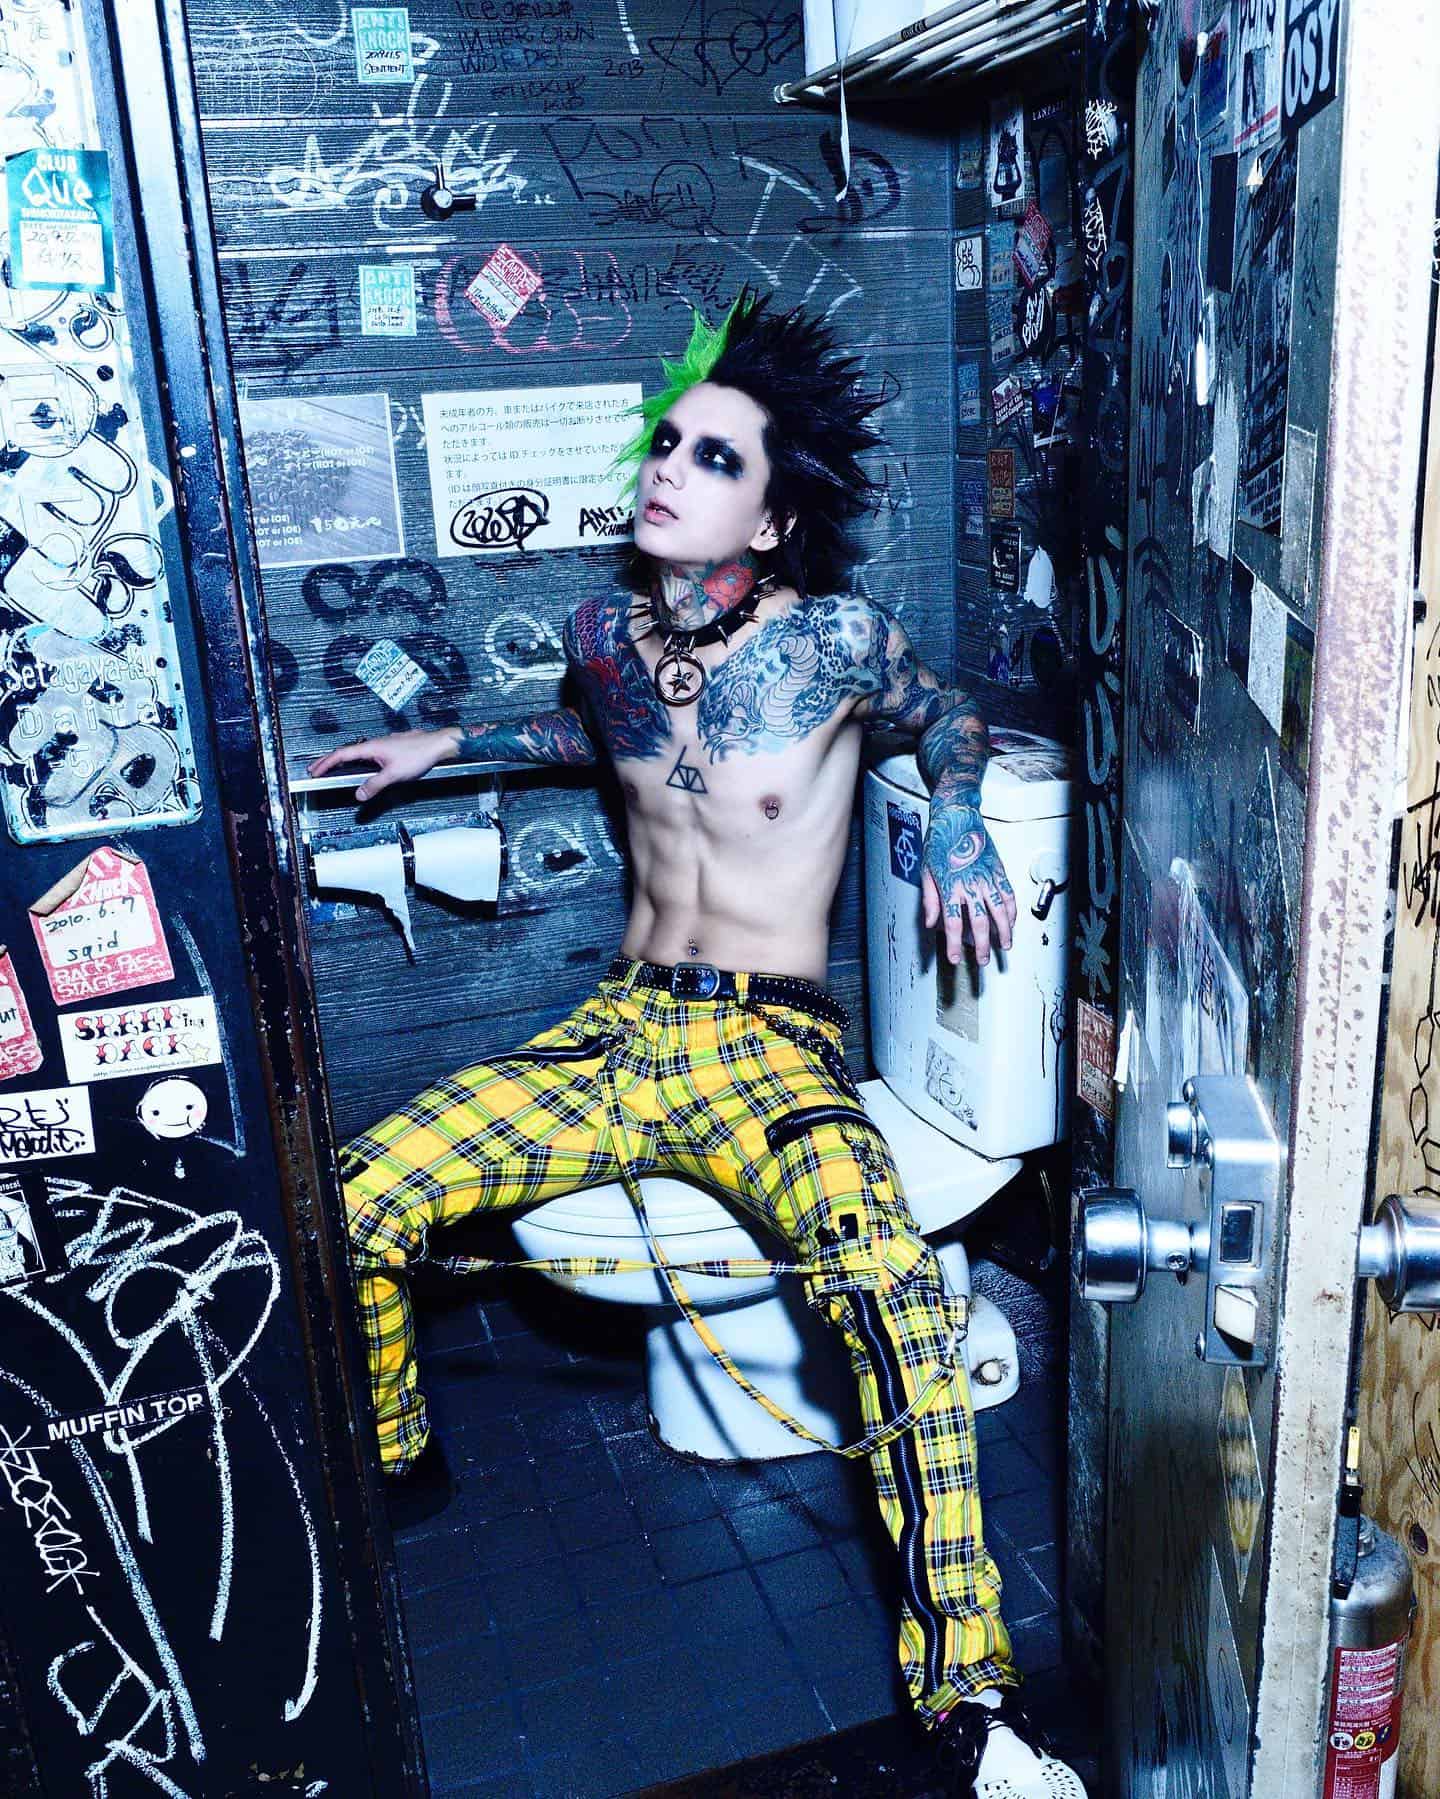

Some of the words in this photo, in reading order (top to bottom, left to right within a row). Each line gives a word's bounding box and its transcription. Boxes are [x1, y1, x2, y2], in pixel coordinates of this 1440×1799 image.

[36, 153, 77, 172] CLUB
[21, 167, 95, 210] Que
[48, 1404, 145, 1441] MUFFIN
[150, 1392, 204, 1416] TOP
